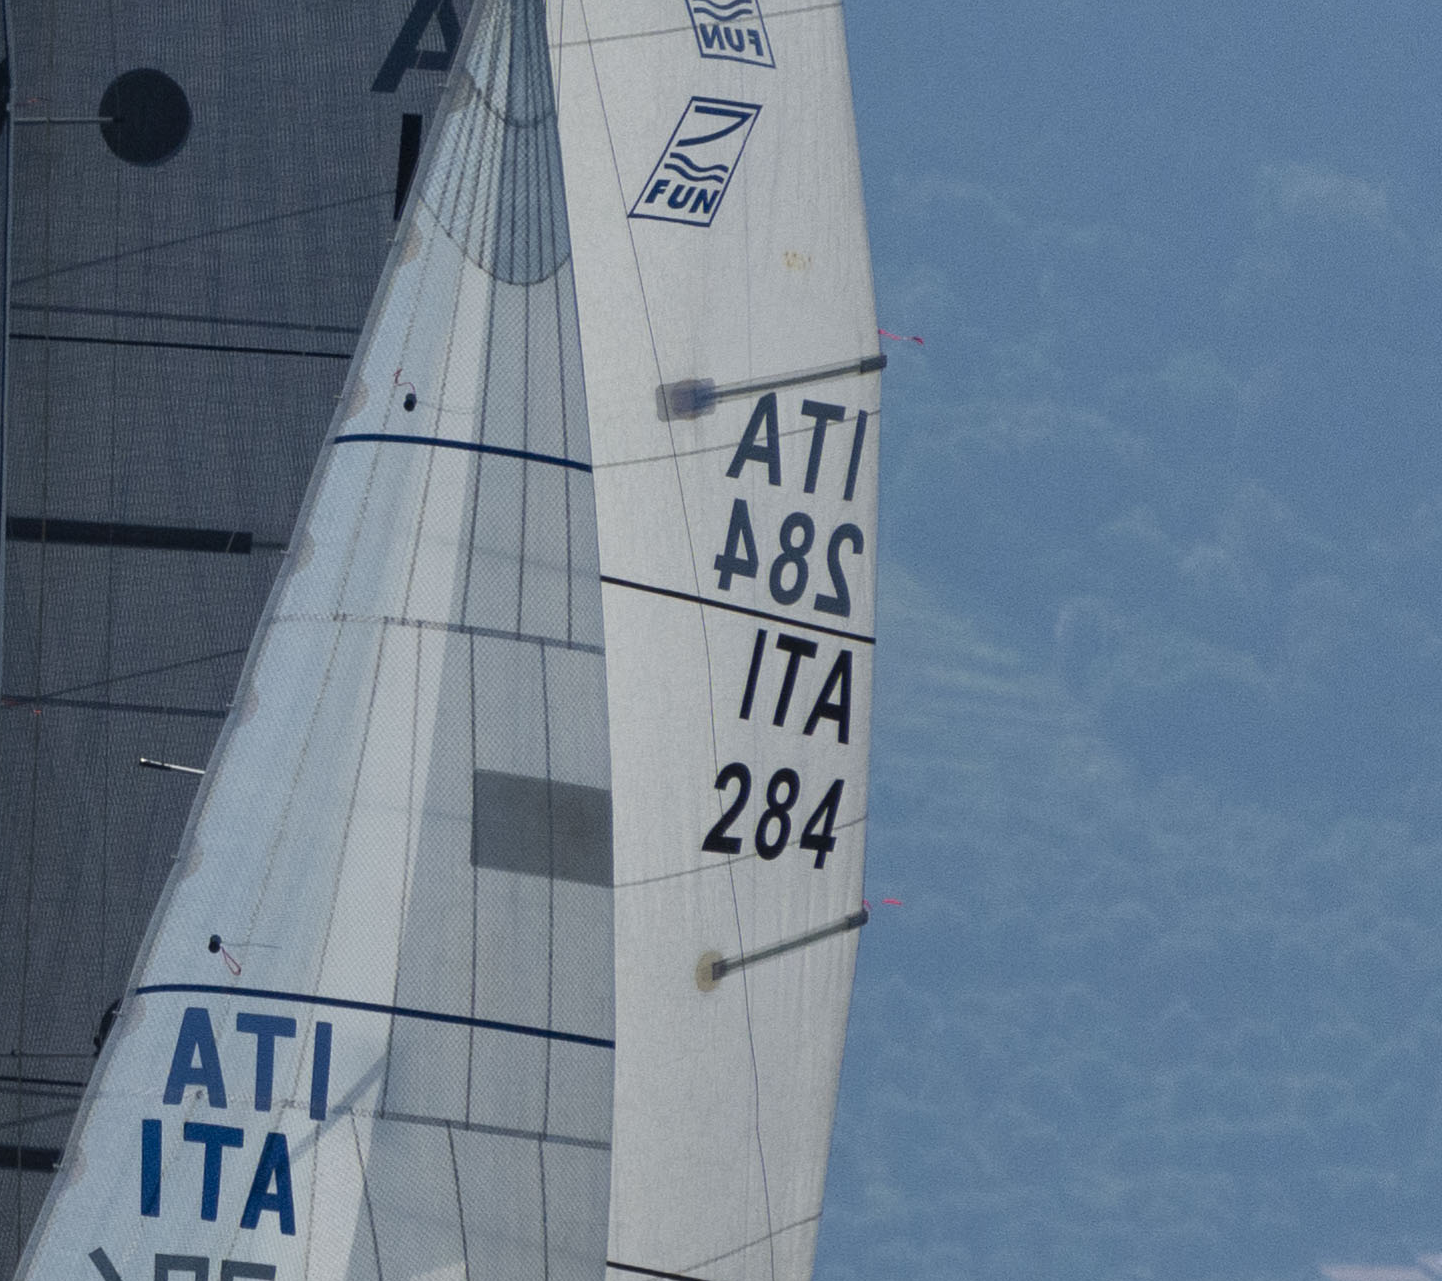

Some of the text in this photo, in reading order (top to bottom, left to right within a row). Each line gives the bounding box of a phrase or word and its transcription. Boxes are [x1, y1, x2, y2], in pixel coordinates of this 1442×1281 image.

[644, 178, 721, 216] FUN
[738, 628, 854, 746] ITA
[701, 761, 845, 870] 284
[139, 1118, 298, 1237] ITA
